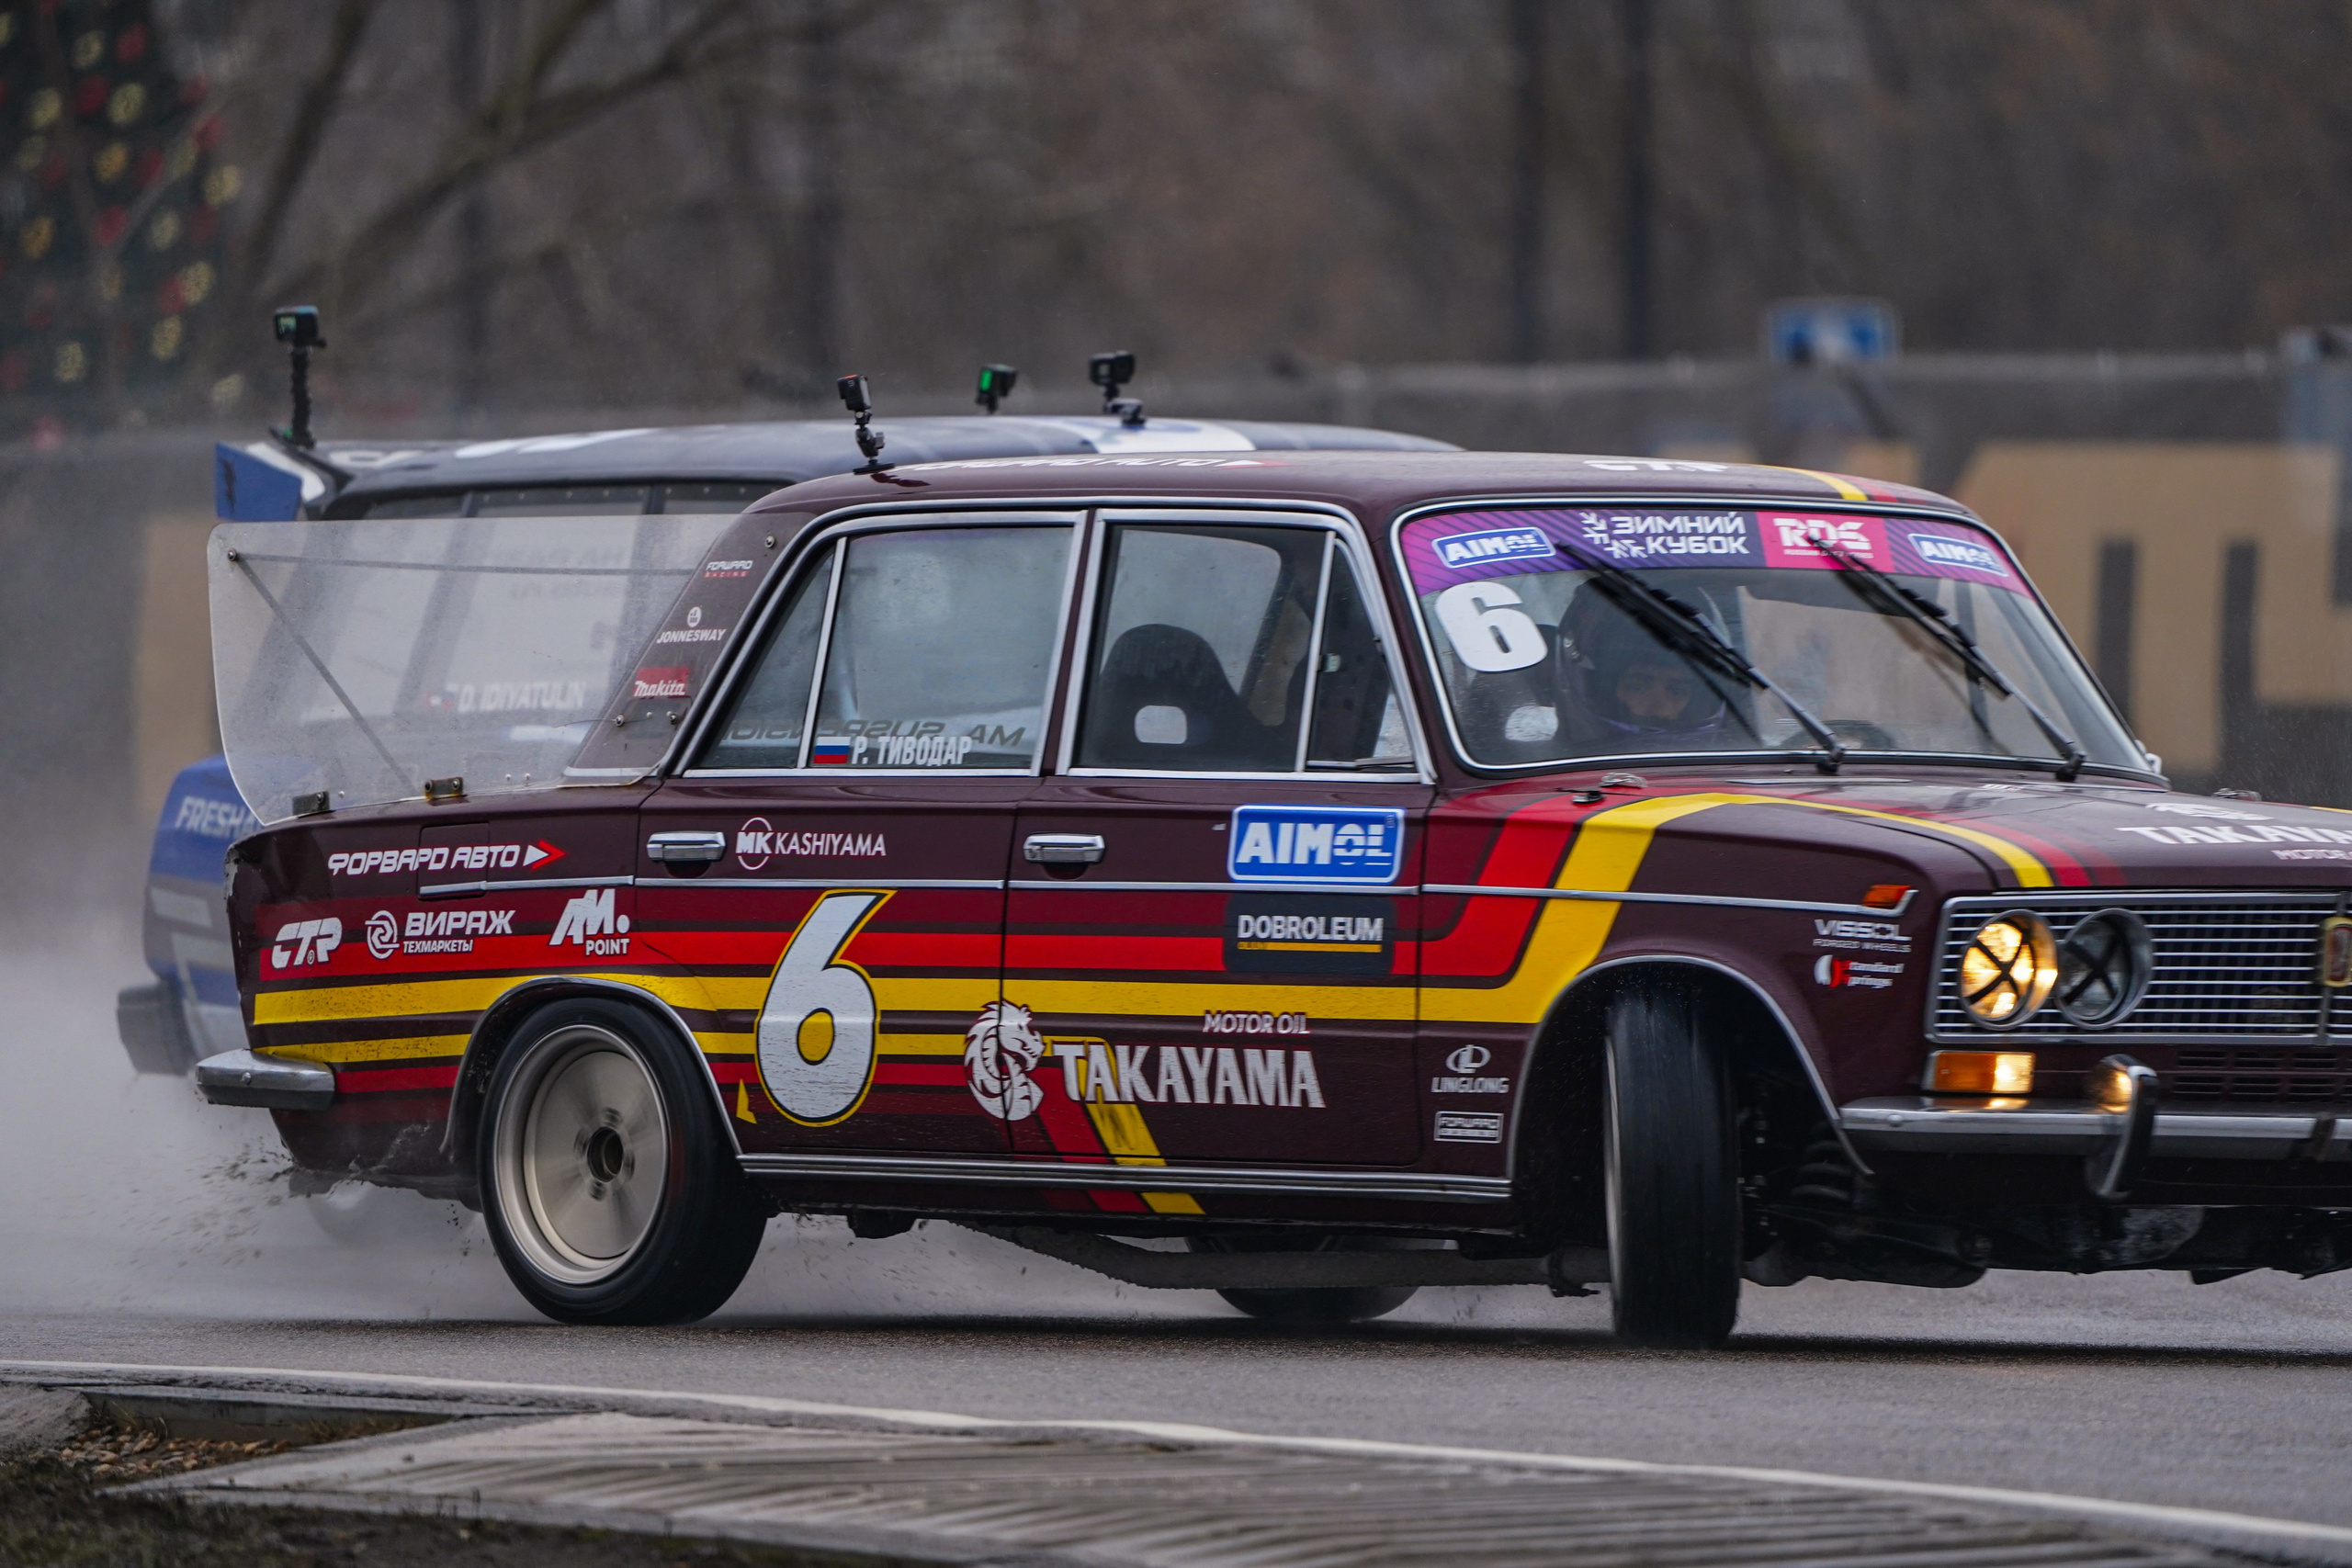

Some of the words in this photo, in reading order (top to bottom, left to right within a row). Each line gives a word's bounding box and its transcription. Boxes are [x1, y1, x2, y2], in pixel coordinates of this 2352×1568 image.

[1611, 512, 1747, 535] ЗИМНИЙ
[1773, 518, 1872, 549] RDS
[1445, 535, 1545, 563] AIMOL
[1646, 536, 1750, 555] КУБОК
[657, 628, 727, 644] JONNESWAY
[1435, 581, 1548, 672] 6
[634, 680, 686, 697] Makita
[851, 737, 869, 764] Р.
[877, 736, 974, 766] ТИВОДАР
[736, 831, 773, 854] MK
[774, 831, 887, 857] KASHIYAMA
[1236, 822, 1393, 865] AIMOL
[450, 844, 520, 870] АВТО
[404, 910, 515, 936] ВИРАЖ
[1238, 915, 1384, 941] DOBROLEUM
[272, 917, 342, 968] CTR
[403, 939, 474, 954] ТЕХМАРКЕТЫ
[585, 938, 630, 956] POINT
[755, 889, 897, 1127] 6
[1203, 1012, 1274, 1033] MOTOR
[1276, 1014, 1311, 1034] OIL
[1053, 1044, 1327, 1109] TAKAYAMA
[1430, 1077, 1510, 1093] LINGLONG
